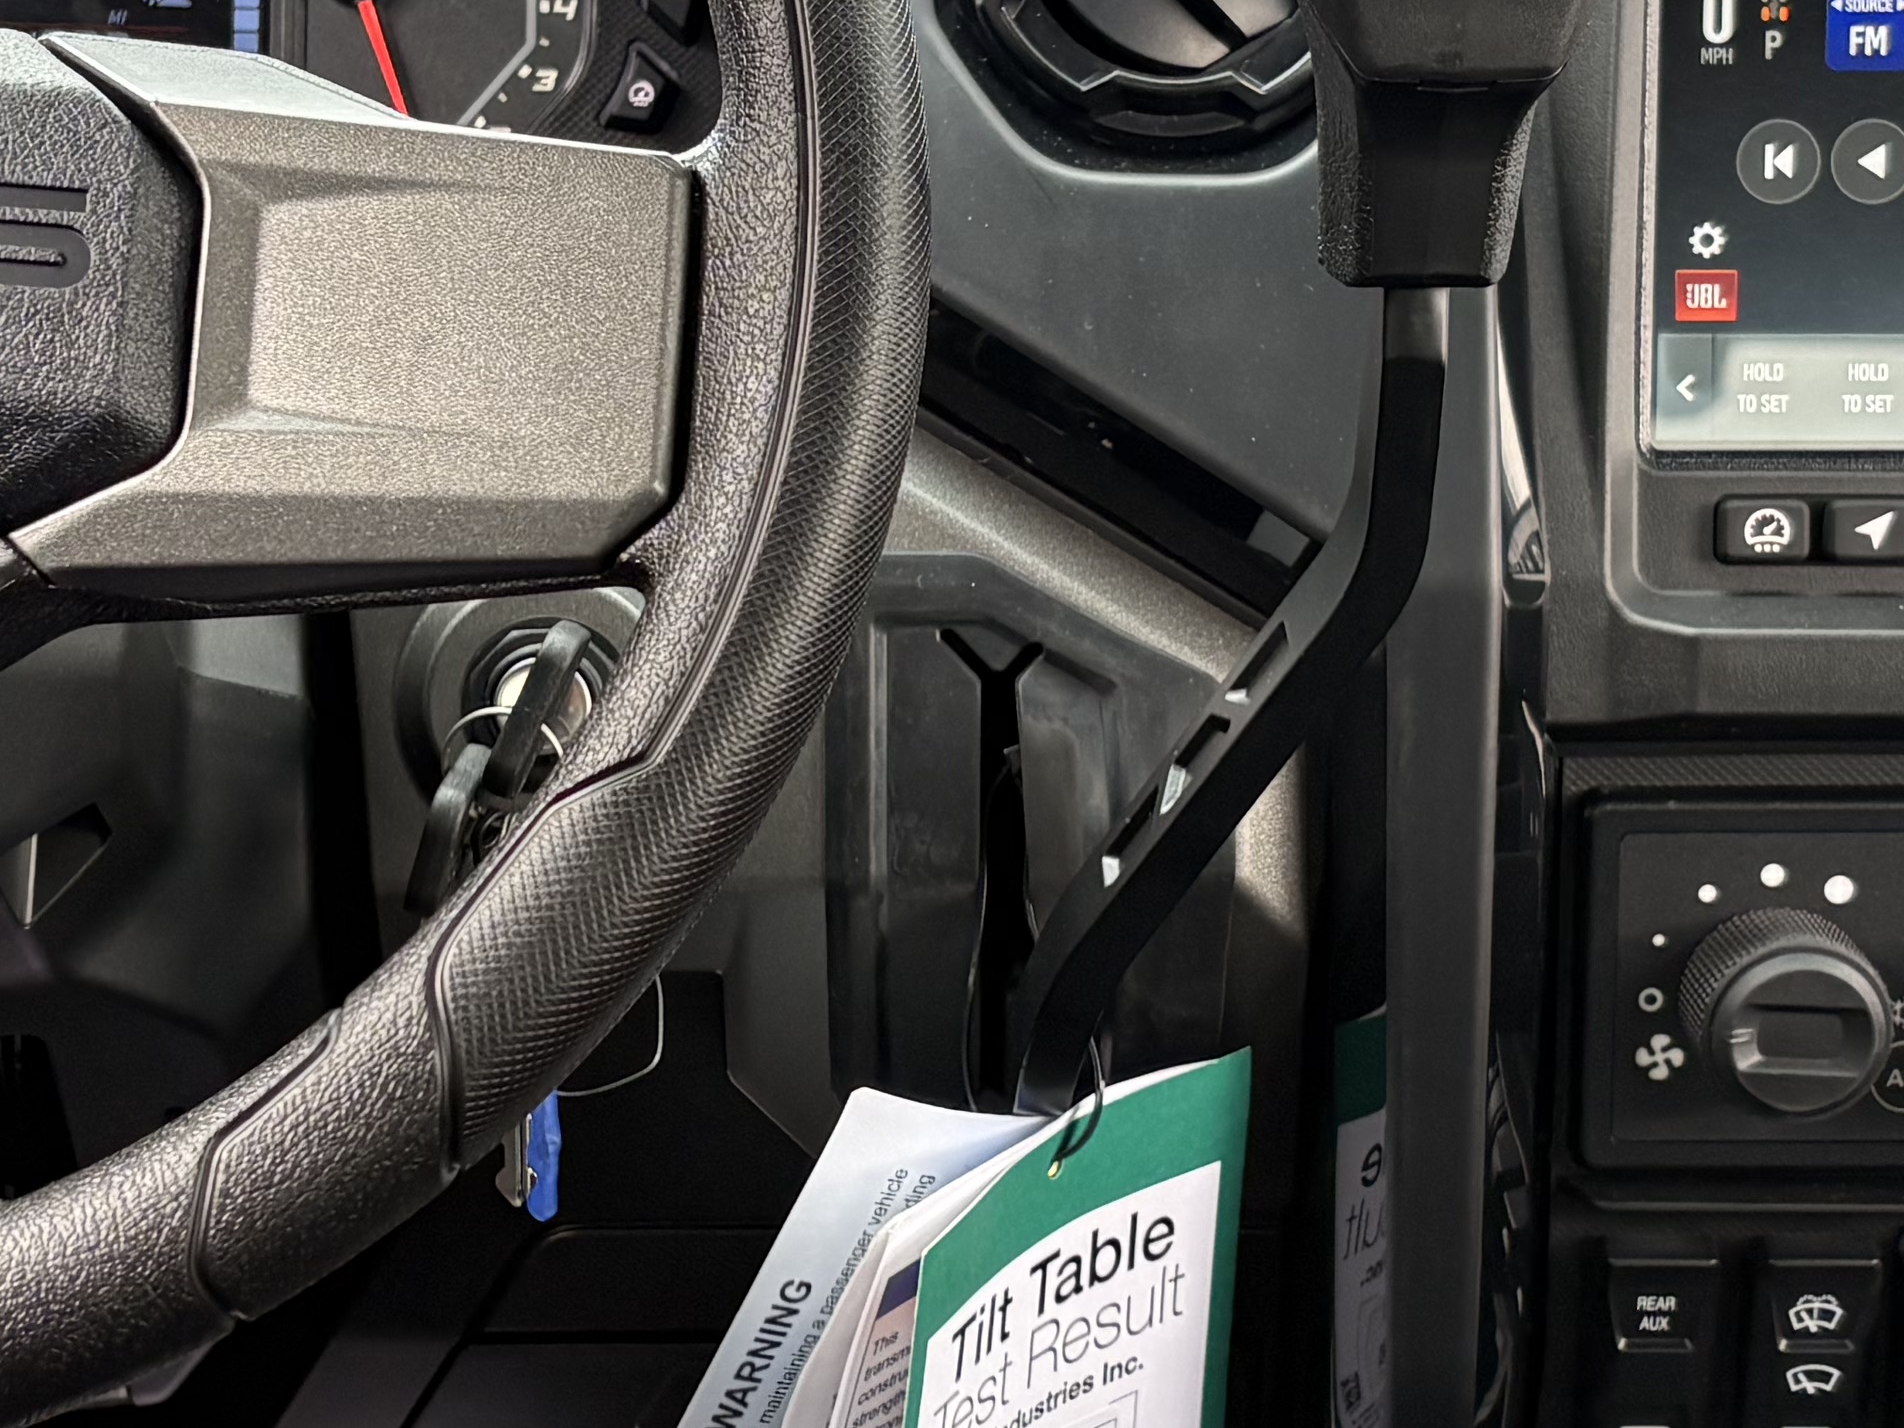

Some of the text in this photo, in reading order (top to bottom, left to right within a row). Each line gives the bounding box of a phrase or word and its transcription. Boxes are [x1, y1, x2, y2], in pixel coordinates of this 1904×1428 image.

[108, 10, 128, 25] MI
[1764, 30, 1784, 60] P
[1849, 25, 1889, 56] FM
[1700, 47, 1734, 65] MPH
[532, 68, 559, 91] 3
[1685, 284, 1727, 309] JBL
[1743, 363, 1783, 383] HOLD
[1848, 363, 1889, 383] HOLD
[1738, 394, 1789, 414] TO SET
[1842, 394, 1894, 414] TO SET
[868, 1168, 908, 1225] vehicle
[952, 1211, 1175, 1383] Tilt Table
[1637, 1295, 1676, 1312] REAR
[1027, 1262, 1185, 1389] Result
[1639, 1314, 1670, 1332] AUX
[1102, 1355, 1144, 1386] Inc.
